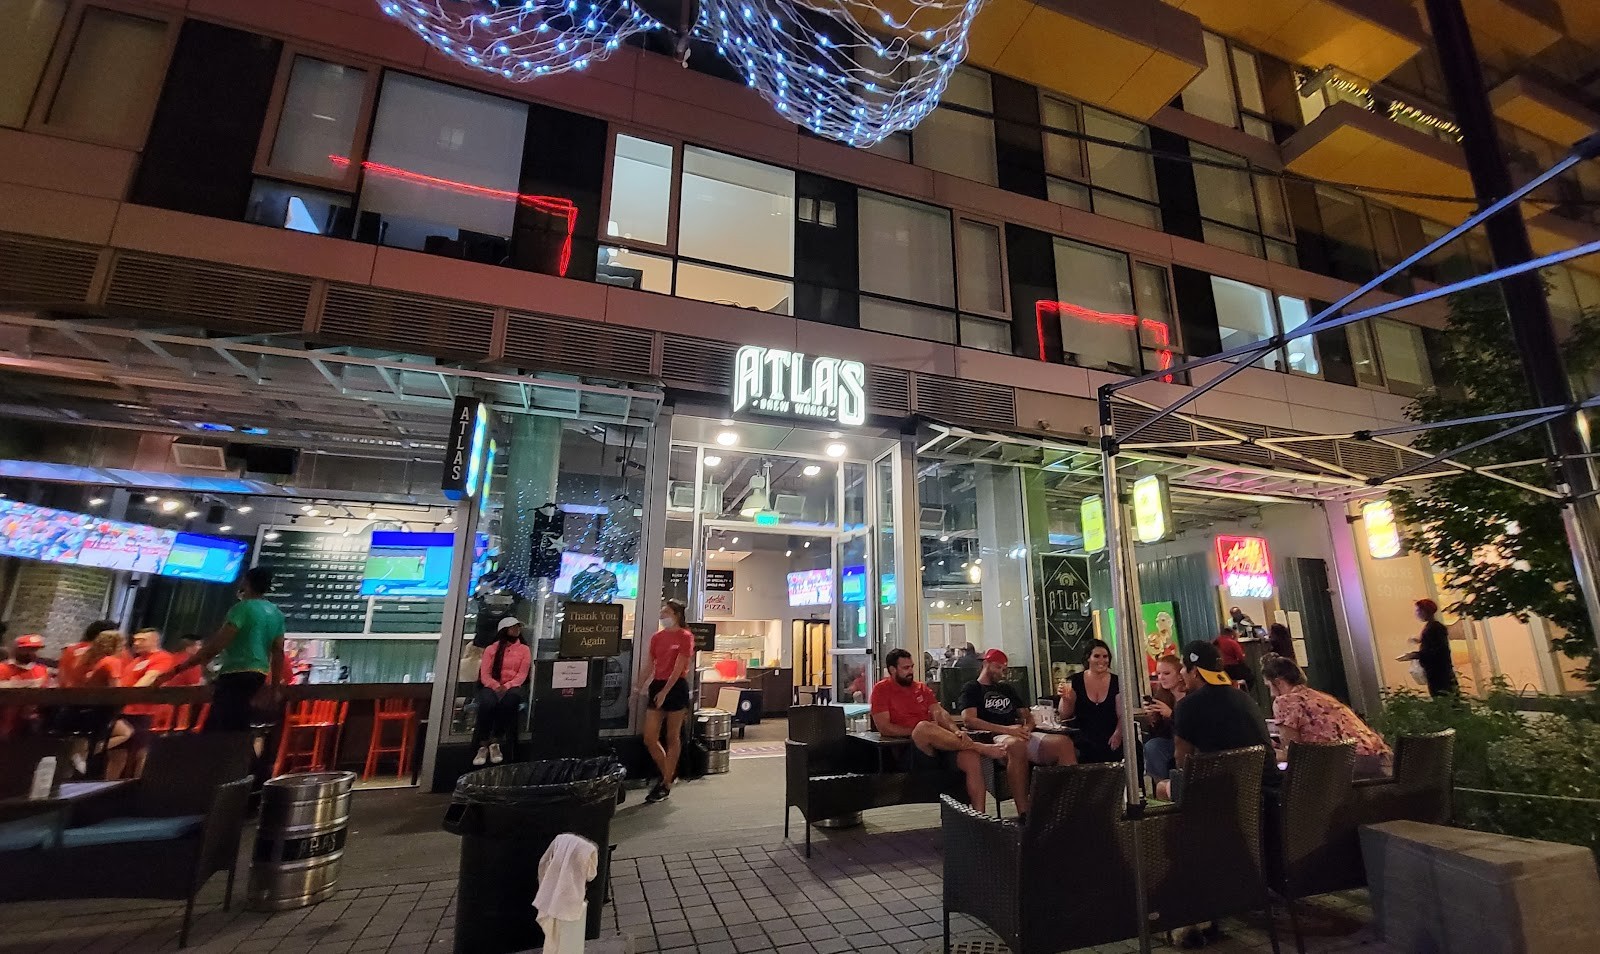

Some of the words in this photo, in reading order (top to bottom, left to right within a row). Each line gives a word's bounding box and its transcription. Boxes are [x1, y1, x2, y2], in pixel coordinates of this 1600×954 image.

[733, 345, 865, 425] ATLAS
[760, 398, 789, 412] BREW
[794, 402, 829, 417] WORKS
[452, 406, 470, 480] ATLAS
[1049, 589, 1090, 617] ATLAS
[570, 611, 598, 620] Thank
[568, 624, 594, 633] Please
[595, 625, 619, 633] Come
[580, 636, 606, 647] Again
